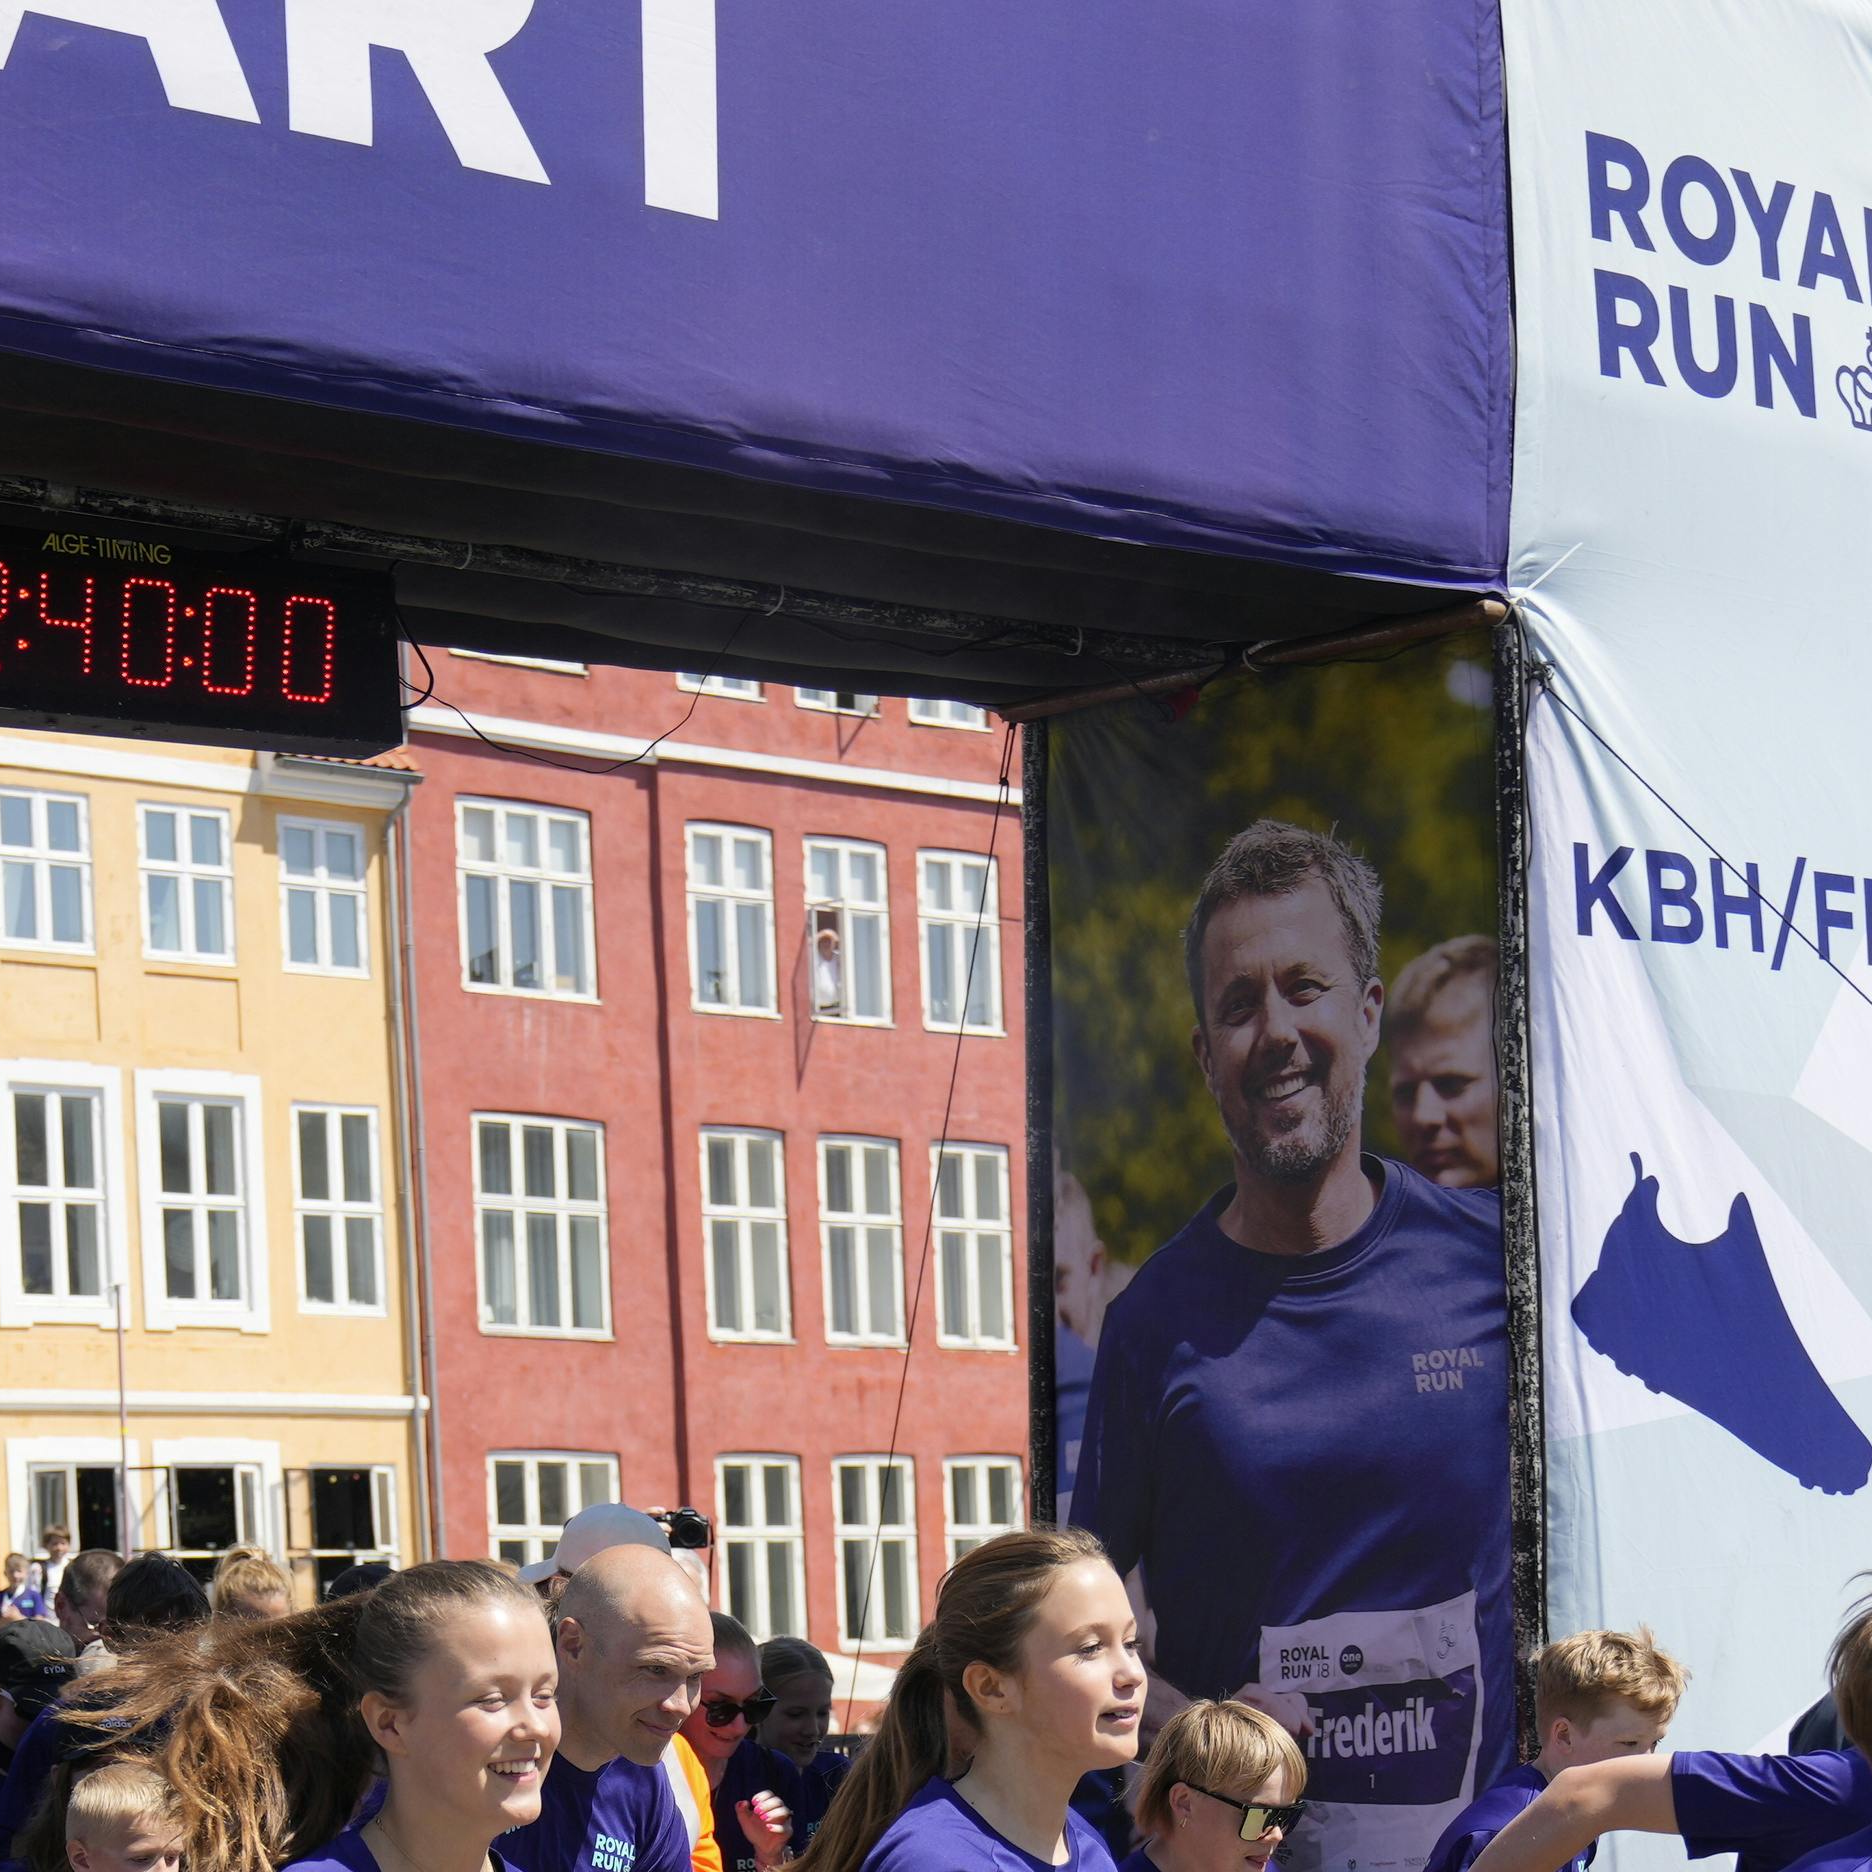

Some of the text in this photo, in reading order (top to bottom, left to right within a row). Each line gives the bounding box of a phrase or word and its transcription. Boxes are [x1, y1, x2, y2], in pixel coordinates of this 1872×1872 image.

[1594, 267, 1818, 419] RUN
[1412, 1347, 1485, 1373] ROYAL
[1414, 1369, 1464, 1393] RUN
[1280, 1645, 1362, 1664] ROYAL one
[43, 1665, 66, 1675] EYDA
[1281, 1663, 1331, 1680] RUN 18
[1307, 1696, 1438, 1759] Frederik
[1369, 1773, 1376, 1789] 1
[595, 1833, 636, 1862] ROYAL
